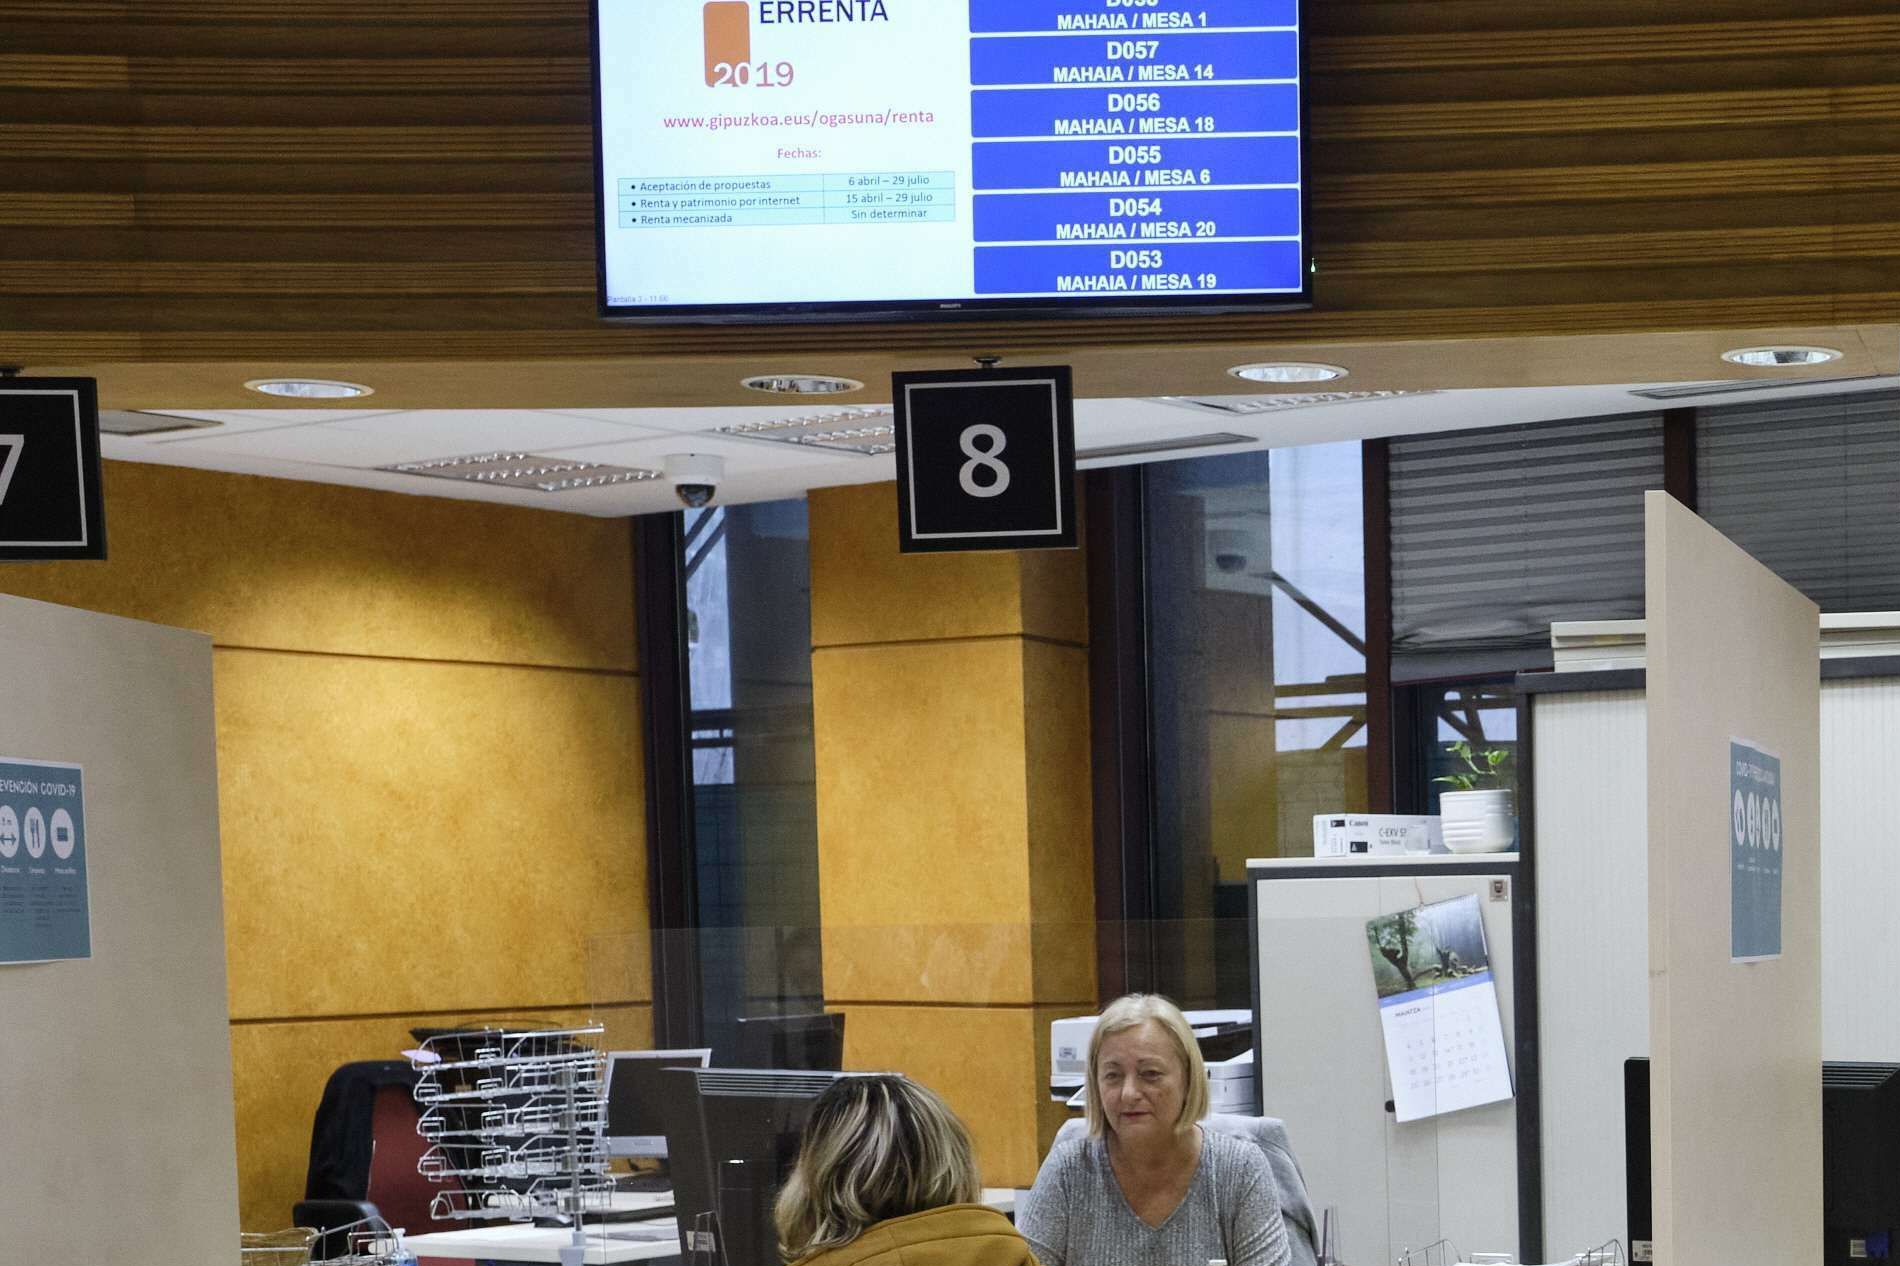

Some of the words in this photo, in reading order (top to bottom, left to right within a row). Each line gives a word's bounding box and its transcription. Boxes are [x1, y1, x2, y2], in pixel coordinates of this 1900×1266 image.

[759, 0, 889, 24] ERRENTA
[1057, 15, 1126, 30] MAHAIA
[1142, 14, 1192, 28] MESA
[1198, 12, 1206, 26] 1
[1107, 42, 1159, 59] D057
[713, 61, 794, 88] 2019
[1053, 67, 1123, 82] MAHAIA
[1139, 66, 1188, 80] MESA
[1194, 65, 1214, 79] 14
[1108, 94, 1160, 111] D056
[663, 109, 934, 129] www.gipuzkoa.eus/ogasuna/renta
[1054, 120, 1124, 135] MAHAIA
[1139, 118, 1189, 132] MESA
[1195, 117, 1214, 131] 18
[777, 147, 822, 160] Fechas:
[1108, 146, 1161, 164] D055
[640, 180, 696, 192] Aceptación
[698, 181, 712, 190] de
[714, 179, 771, 192] propuestas
[849, 176, 855, 186] 6
[858, 175, 880, 186] abril
[894, 175, 905, 186] 29
[907, 174, 930, 187] julio
[1060, 172, 1130, 187] MAHAIA
[1145, 170, 1195, 185] MESA
[1200, 170, 1210, 184] 6
[640, 198, 669, 208] Renta
[680, 196, 737, 209] patrimonio
[739, 198, 756, 208] por
[758, 195, 800, 206] internet
[847, 193, 858, 203] 15
[860, 192, 883, 203] abril
[896, 192, 908, 202] 29
[910, 192, 933, 204] julio
[851, 209, 867, 218] Sin
[870, 208, 927, 218] determinar
[1109, 199, 1162, 216] D054
[640, 214, 671, 224] Renta
[673, 212, 732, 223] mecanizada
[1056, 224, 1126, 239] MAHAIA
[1141, 223, 1191, 237] MESA
[1196, 222, 1215, 236] 20
[1110, 251, 1162, 268] D053
[1057, 276, 1126, 291] MAHAIA
[1142, 275, 1192, 289] MESA
[1197, 274, 1216, 288] 19
[959, 424, 1010, 497] 8
[40, 782, 76, 797] COVID-19
